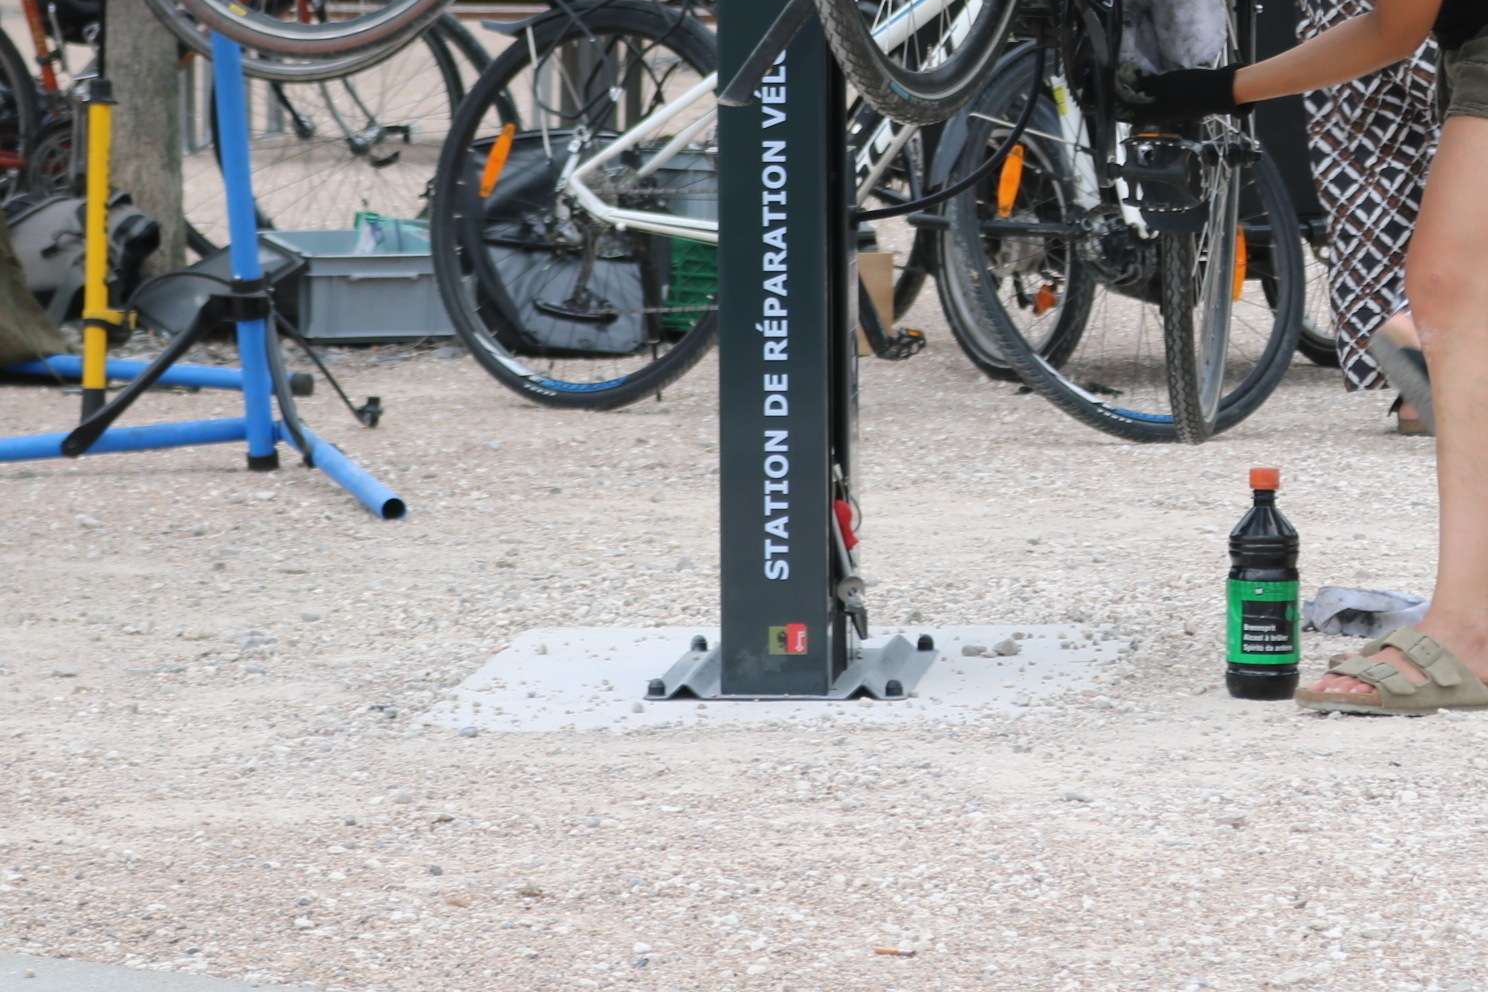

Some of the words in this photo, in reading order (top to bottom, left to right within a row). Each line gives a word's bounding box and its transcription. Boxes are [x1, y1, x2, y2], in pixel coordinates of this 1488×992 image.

[754, 49, 787, 129] VÉL
[755, 139, 789, 362] RÉPARATION
[764, 373, 789, 417] DE
[764, 429, 790, 581] STATION
